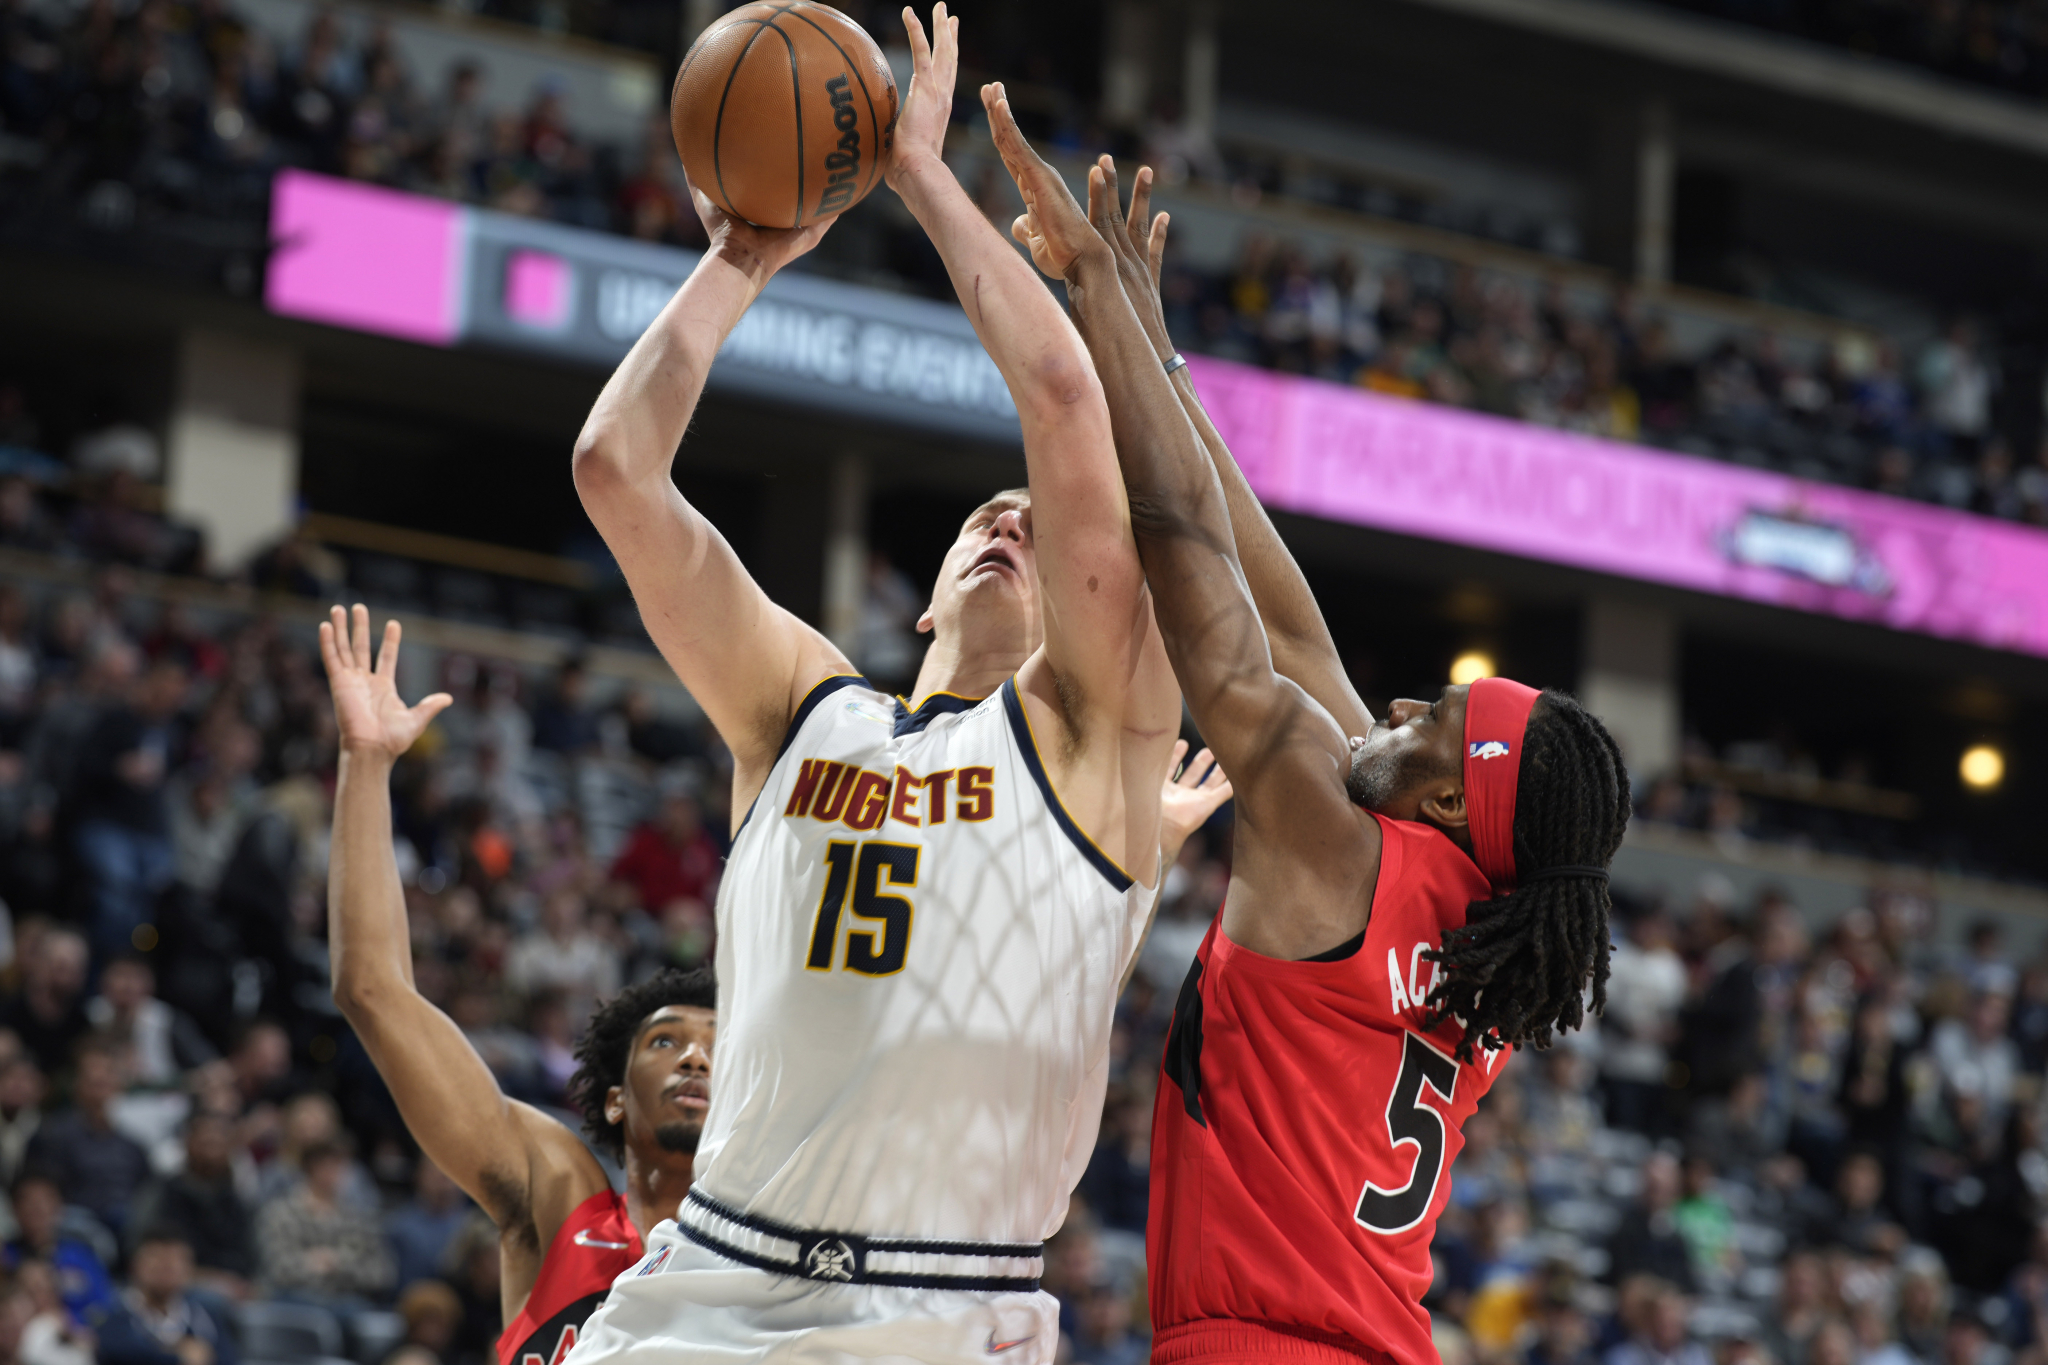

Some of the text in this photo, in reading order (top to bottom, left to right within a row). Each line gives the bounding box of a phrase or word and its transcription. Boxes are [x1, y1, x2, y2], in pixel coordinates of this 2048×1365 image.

[813, 72, 861, 217] Wilson
[783, 758, 995, 832] NUGETS
[804, 838, 923, 979] 15
[1353, 1029, 1461, 1236] 5
